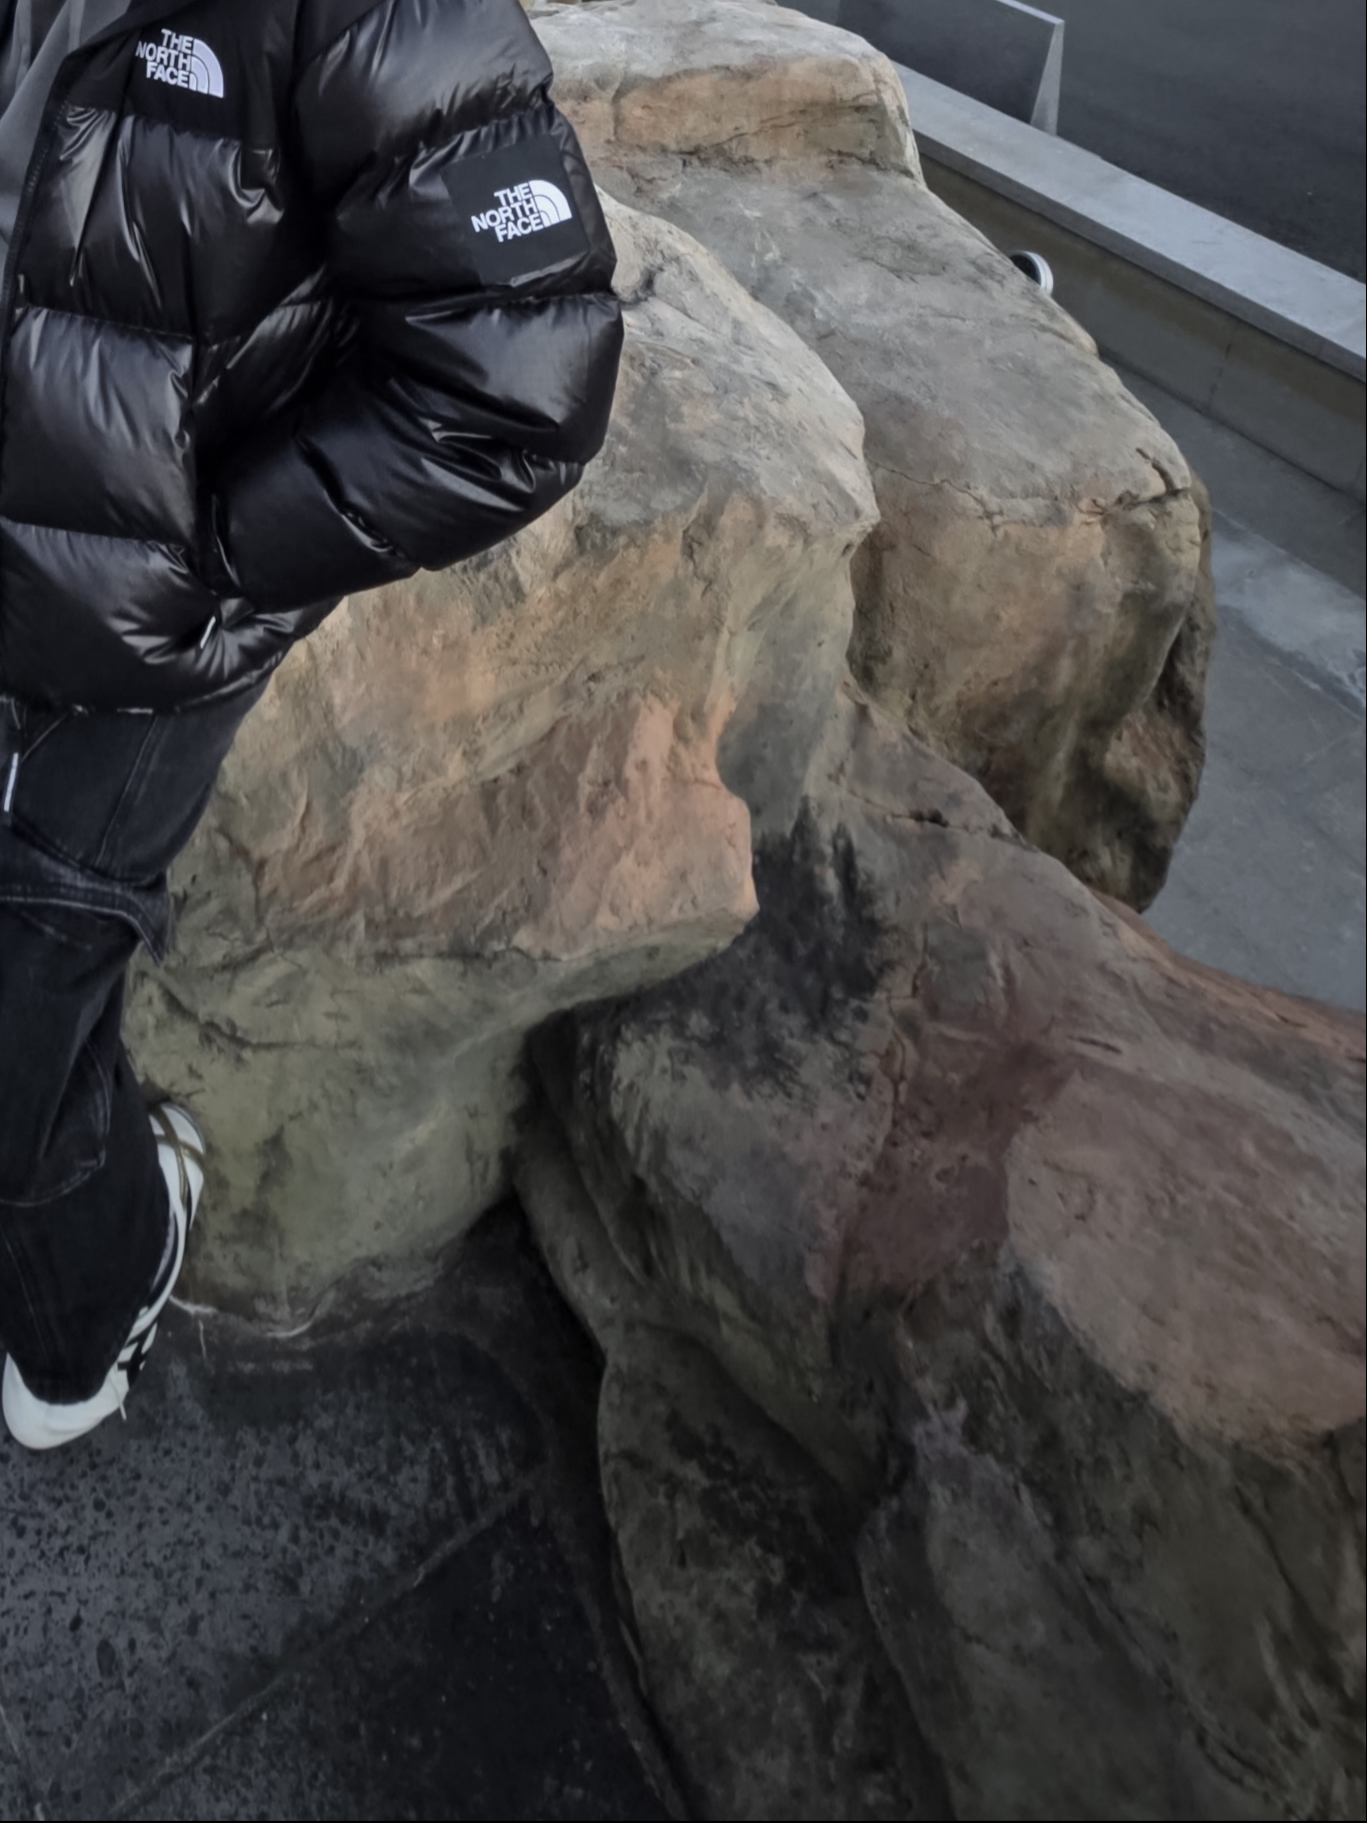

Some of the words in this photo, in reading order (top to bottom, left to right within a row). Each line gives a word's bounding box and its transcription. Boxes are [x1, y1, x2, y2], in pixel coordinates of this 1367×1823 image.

[135, 40, 192, 73] NORTH
[161, 28, 194, 55] THE
[146, 60, 190, 89] FACE
[493, 182, 533, 207] THE
[470, 196, 539, 233] NORTH
[494, 211, 545, 243] FACE
